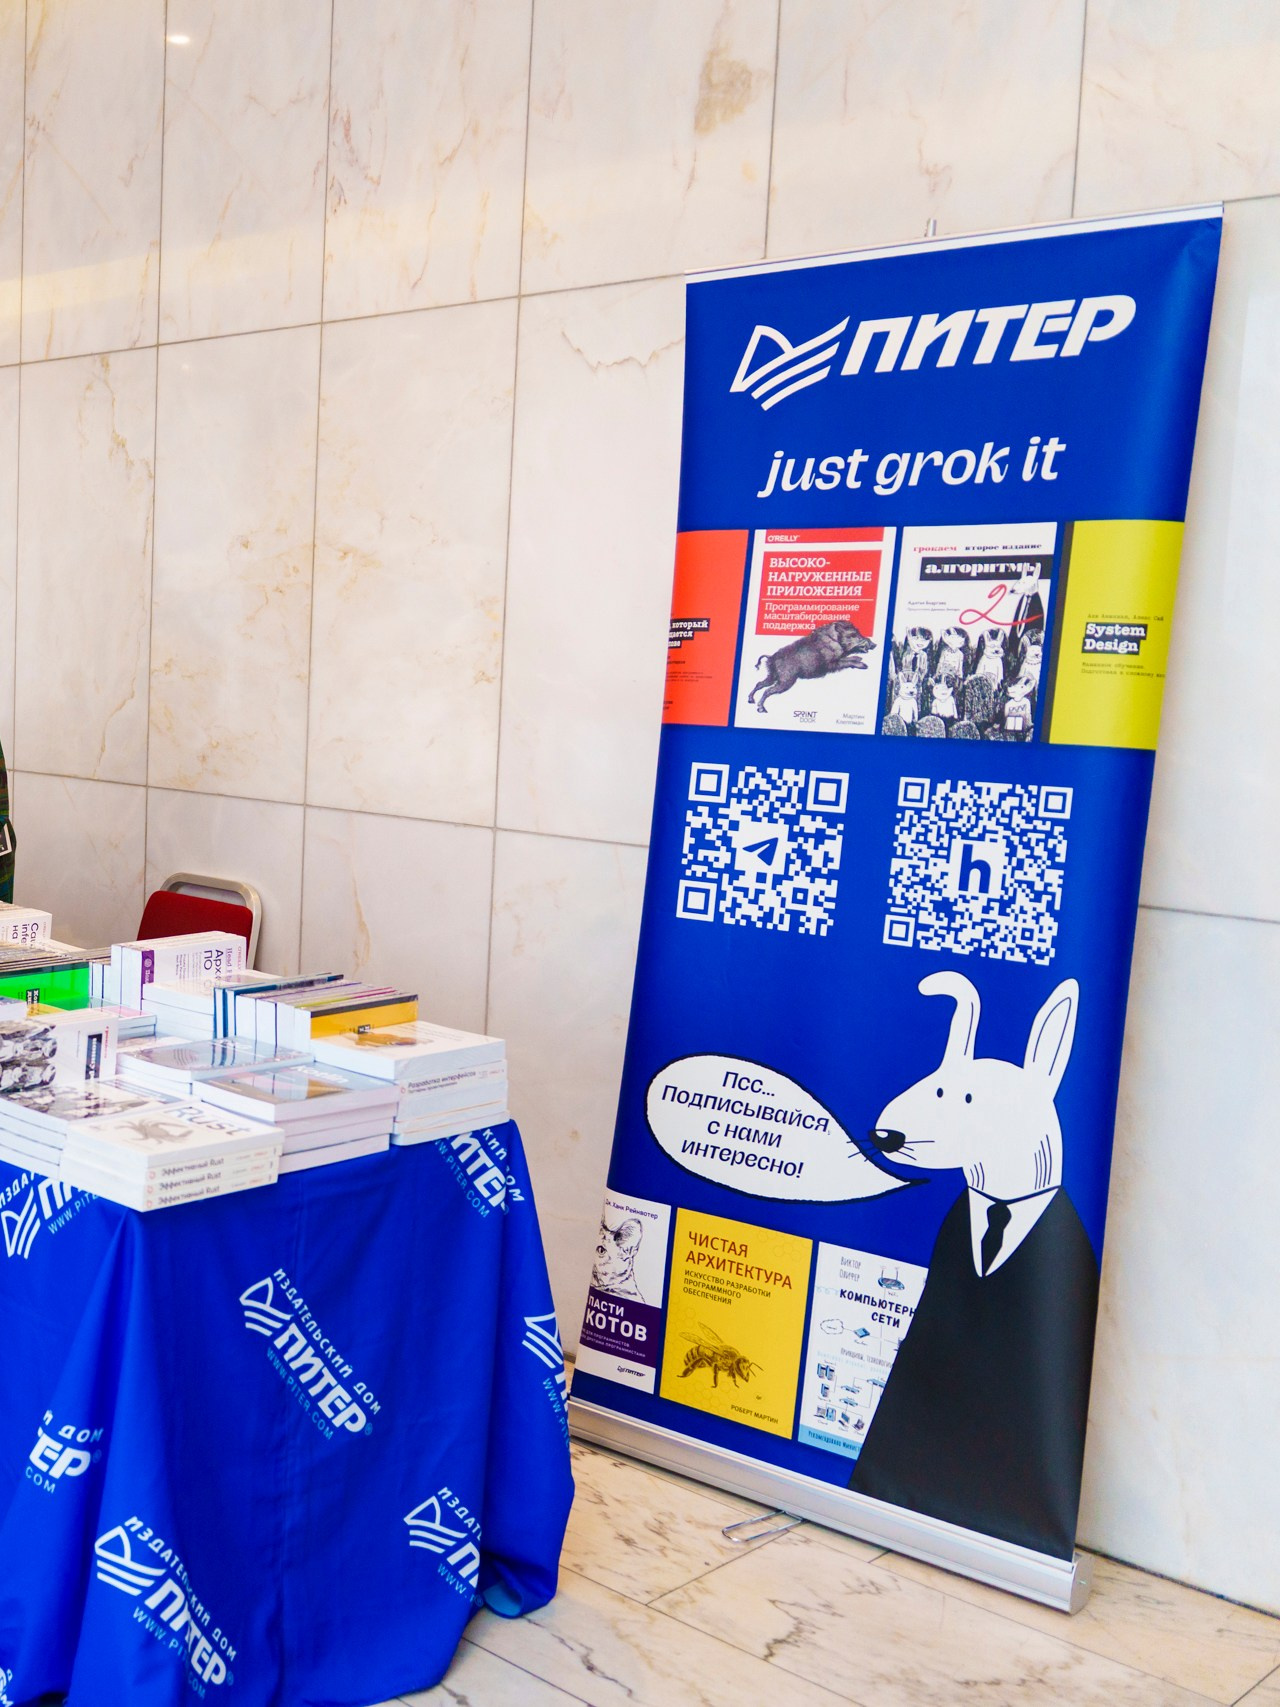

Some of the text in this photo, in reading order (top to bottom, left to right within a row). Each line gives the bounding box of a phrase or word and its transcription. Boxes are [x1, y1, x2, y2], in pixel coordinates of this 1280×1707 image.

[840, 294, 1136, 376] ПИТЕР
[757, 436, 1066, 498] just grok it
[769, 557, 831, 568] ВЫСОКО-
[924, 562, 1037, 577] алгоритмы
[768, 571, 872, 582] НАГРУЖЕННЫЕ
[766, 585, 862, 596] ПРИЛОЖЕНИЯ
[764, 612, 851, 622] масштабирование
[765, 602, 859, 613] Программирование
[672, 620, 708, 630] который
[763, 622, 816, 632] поддержка
[1086, 623, 1146, 638] System
[1084, 639, 1139, 654] Design
[203, 950, 213, 971] ПО
[722, 1071, 776, 1097] Псс...
[164, 1106, 252, 1136] Rust
[707, 1120, 782, 1148] с нами
[210, 1158, 224, 1168] Rust
[681, 1138, 805, 1179] интересно!
[207, 1172, 222, 1182] Rust
[206, 1186, 220, 1195] Rust
[688, 1231, 749, 1258] ЧИСТАЯ
[685, 1250, 793, 1290] АРХИТЕКТУРА
[840, 1256, 862, 1270] ВИКТОР
[683, 1278, 742, 1300] ПРОГРАММНОГО
[684, 1269, 771, 1299] ИСКУССТВО РАЗРАБОТКИ
[588, 1295, 625, 1317] ПАСТИ
[682, 1287, 732, 1306] ОБЕСПЕЧЕНИЯ
[585, 1308, 648, 1342] КОТОВ
[871, 1311, 901, 1329] СЕТИ
[273, 1268, 381, 1415] ИЗДАТЕЛЬСКИЙ ДОМ
[273, 1323, 367, 1433] ПИТЕР
[267, 1347, 334, 1440] WWW.PITER.COM
[731, 1404, 779, 1425] РОБЕРТ МАРТИН
[58, 1423, 104, 1444] ДОМ
[211, 1627, 238, 1662] ДОМ
